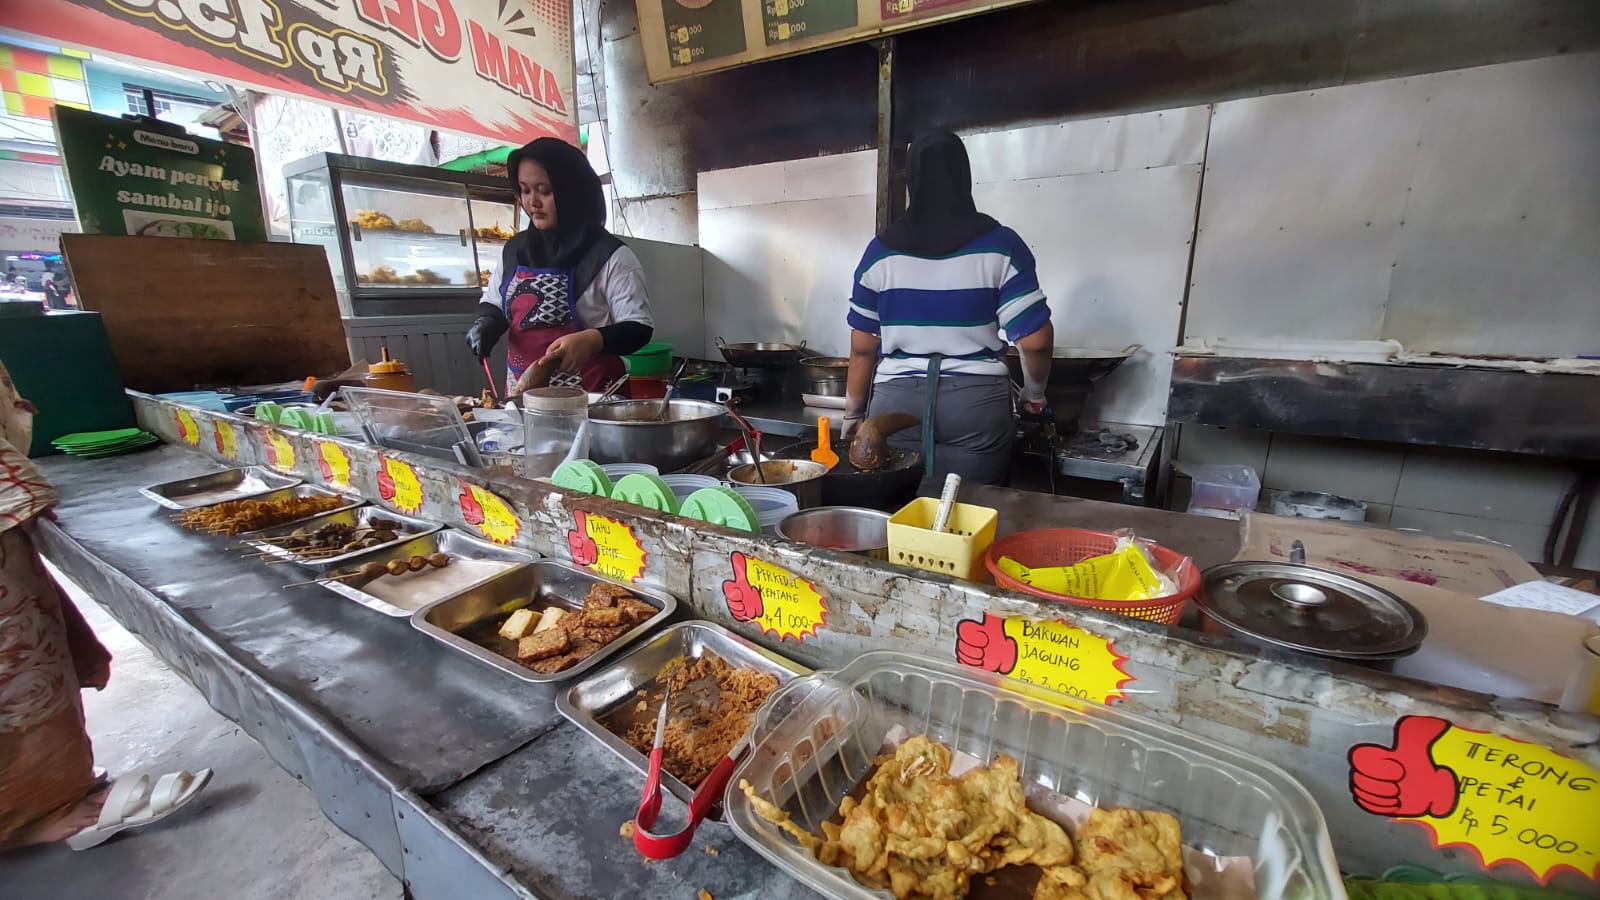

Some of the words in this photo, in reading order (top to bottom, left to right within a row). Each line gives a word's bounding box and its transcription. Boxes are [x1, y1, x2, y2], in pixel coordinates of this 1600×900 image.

[140, 133, 169, 147] Menu
[170, 140, 195, 152] baru
[98, 156, 166, 180] Ayam
[170, 169, 240, 192] penyet
[117, 189, 202, 212] sambal
[205, 201, 231, 218] ijo
[589, 519, 610, 535] TAHU
[758, 583, 799, 603] KENTANG
[1022, 620, 1080, 648] BAKWAN
[1021, 641, 1080, 671] JAGUNG
[1464, 740, 1598, 791] TERONG
[1459, 775, 1537, 811] PETAI
[1506, 776, 1525, 790] &
[1459, 806, 1479, 837] Rp
